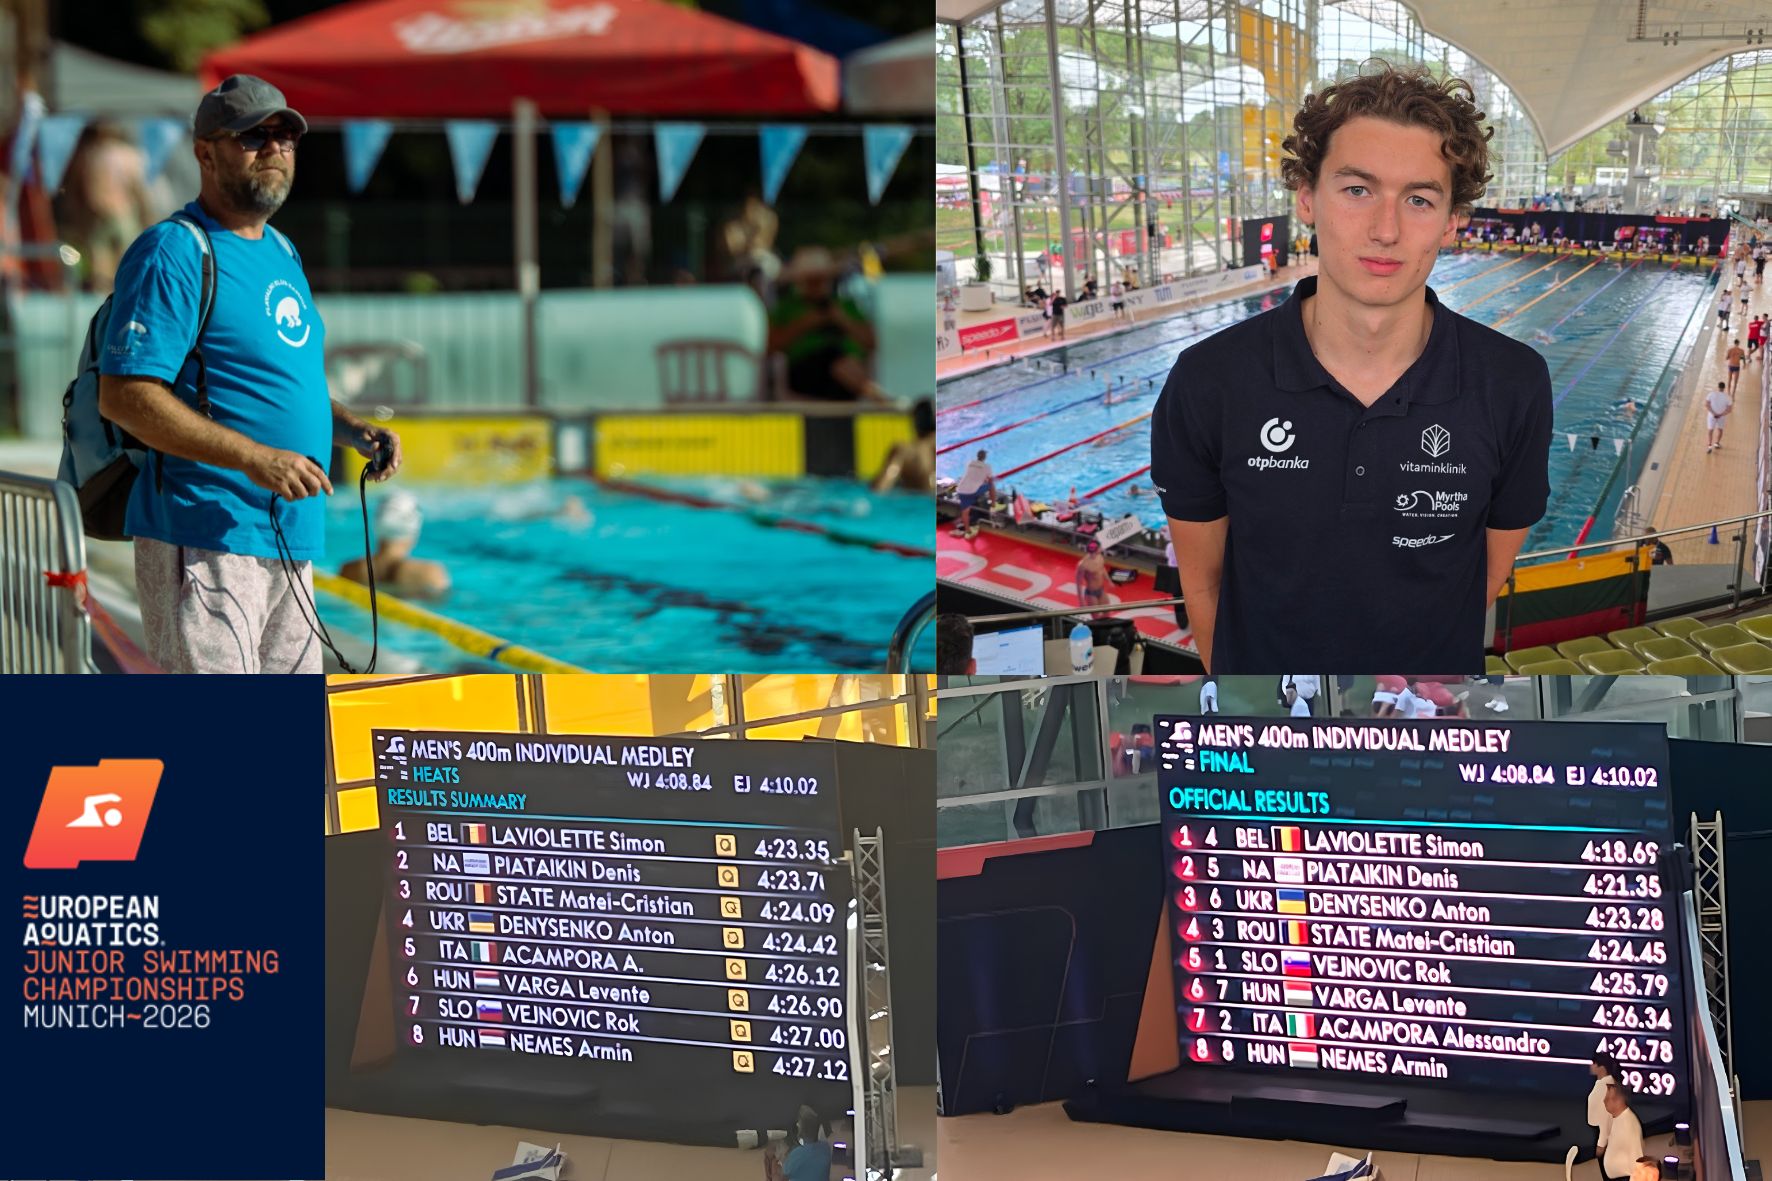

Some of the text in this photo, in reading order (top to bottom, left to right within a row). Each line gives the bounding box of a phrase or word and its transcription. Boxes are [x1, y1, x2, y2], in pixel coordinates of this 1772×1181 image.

[1248, 456, 1309, 470] otpbanka
[1400, 461, 1466, 474] vitaminklinik
[1435, 501, 1460, 511] Pools
[1436, 491, 1468, 503] Myrtha
[1392, 534, 1437, 548] speedo
[412, 740, 694, 768] MEN'S 400m INDIVIDUAL MEDLEY
[1198, 724, 1511, 752] MEN'S 400m INDIVIDUAL MEDLEY
[413, 766, 460, 784] HEATS
[1200, 751, 1254, 773] FINAL
[1459, 763, 1555, 784] WJ 4:08.84
[1566, 766, 1658, 788] EJ 4:10.02
[627, 771, 712, 791] WJ 4:08.84
[734, 775, 818, 795] EJ 4:10.02
[387, 788, 527, 810] RESULTS SUMMARY
[1169, 787, 1330, 814] OFFICIAL RESULTS
[394, 822, 406, 840] 1
[427, 822, 458, 843] BEL
[492, 826, 604, 849] LAVIOLETTE
[610, 830, 665, 853] Simon
[754, 838, 830, 860] 4:23.35
[1179, 825, 1192, 846] 1
[1204, 826, 1218, 846] 4
[1235, 827, 1269, 849] BEL
[1304, 829, 1422, 854] LAVIOLETTE
[1426, 834, 1484, 858] Simon
[397, 850, 409, 870] 2
[433, 853, 461, 873] NA
[495, 855, 587, 878] PIATAIKIN
[592, 861, 640, 882] Denis
[1181, 856, 1194, 876] 2
[1207, 857, 1220, 878] 5
[1242, 858, 1271, 880] NA
[1307, 860, 1403, 885] PIATAIKIN
[1407, 866, 1458, 889] Denis
[1583, 874, 1662, 898] 4:21.35
[400, 880, 411, 899] 3
[426, 882, 462, 902] ROU
[496, 885, 554, 907] STATE
[559, 888, 694, 916] Matei-Cristian
[760, 900, 835, 924] 4:24.09
[1184, 886, 1664, 930] 3 6 UKR DENYSENKO Anton 4:23.28
[402, 909, 413, 927] 4
[430, 910, 465, 931] UKR
[500, 915, 613, 940] DENYSENKO
[618, 922, 674, 945] Anton
[762, 932, 838, 956] 4:24.42
[1186, 916, 1667, 964] 4 3 ROU STATE Matei-Cristian 4:24.45
[404, 938, 416, 957] 5
[440, 940, 468, 961] ITA
[503, 945, 618, 972] ACAMPORA
[622, 953, 644, 973] A.
[765, 963, 840, 986] 4:26.12
[1189, 947, 1668, 996] 5 1 SLO VEJNOVIC Rok 4:25.79
[407, 966, 418, 985] 6
[434, 969, 470, 990] HUN
[504, 974, 575, 998] VARGA
[578, 980, 650, 1004] Levente
[768, 994, 842, 1018] 4:26.90
[1191, 978, 1672, 1031] 6 7 HUN VARGA Levente 4:26.34
[409, 996, 420, 1014] 7
[438, 998, 472, 1018] SLO
[506, 1002, 600, 1028] VEJNOVIC
[605, 1010, 640, 1033] Rok
[770, 1025, 846, 1049] 4:27.00
[1193, 1008, 1673, 1063] 7 2 ITA ACAMPORA Alessandro 4:26.78
[412, 1024, 424, 1044] 8
[438, 1027, 476, 1048] HUN
[510, 1032, 574, 1057] NEMES
[578, 1039, 633, 1062] Armin
[772, 1056, 848, 1080] 4:27.12
[1196, 1038, 1208, 1058] 8
[1222, 1040, 1234, 1062] 8
[1248, 1042, 1284, 1065] HUN
[1322, 1048, 1386, 1073] NEMES
[1391, 1054, 1448, 1079] Armin
